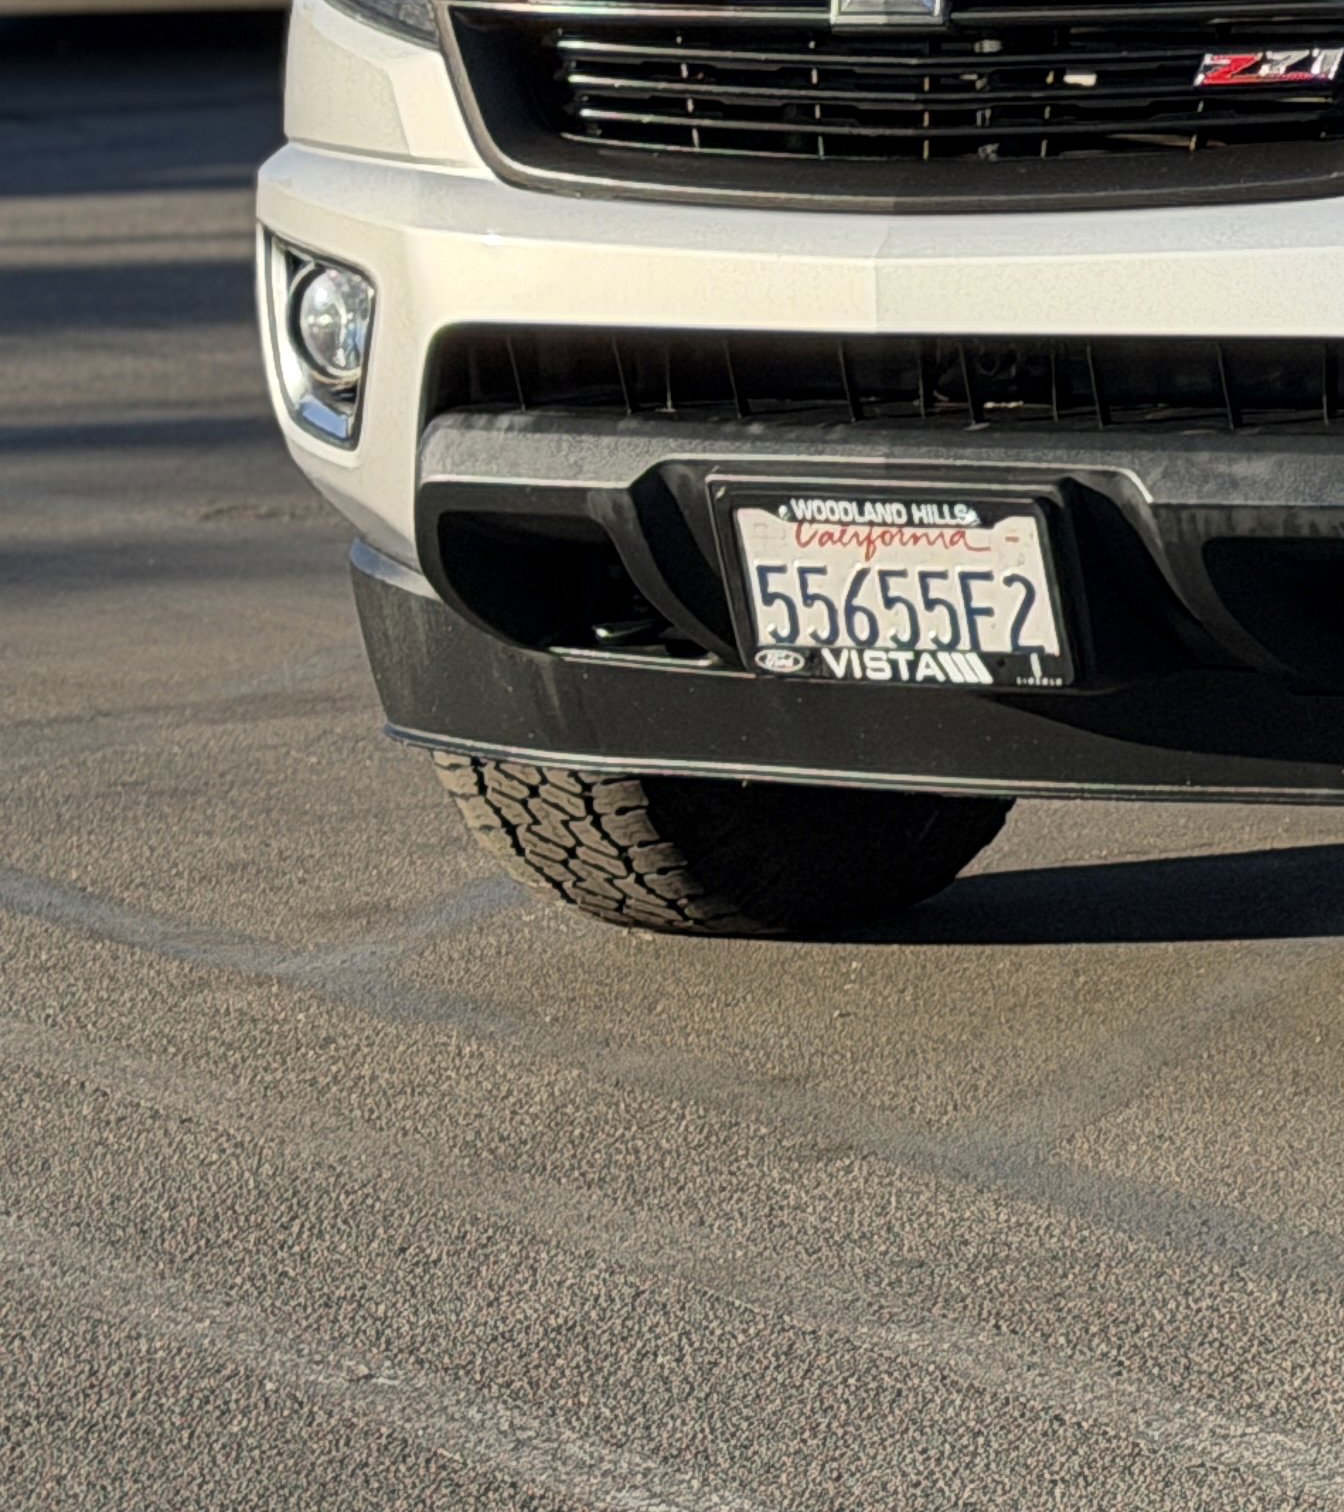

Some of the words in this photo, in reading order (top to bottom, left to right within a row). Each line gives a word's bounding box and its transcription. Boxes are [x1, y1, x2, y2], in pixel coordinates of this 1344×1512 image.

[790, 499, 908, 525] WOODLAND
[911, 502, 968, 526] HILLS
[794, 521, 991, 562] California
[755, 564, 1046, 656] 55655F2
[821, 647, 946, 683] VISTA
